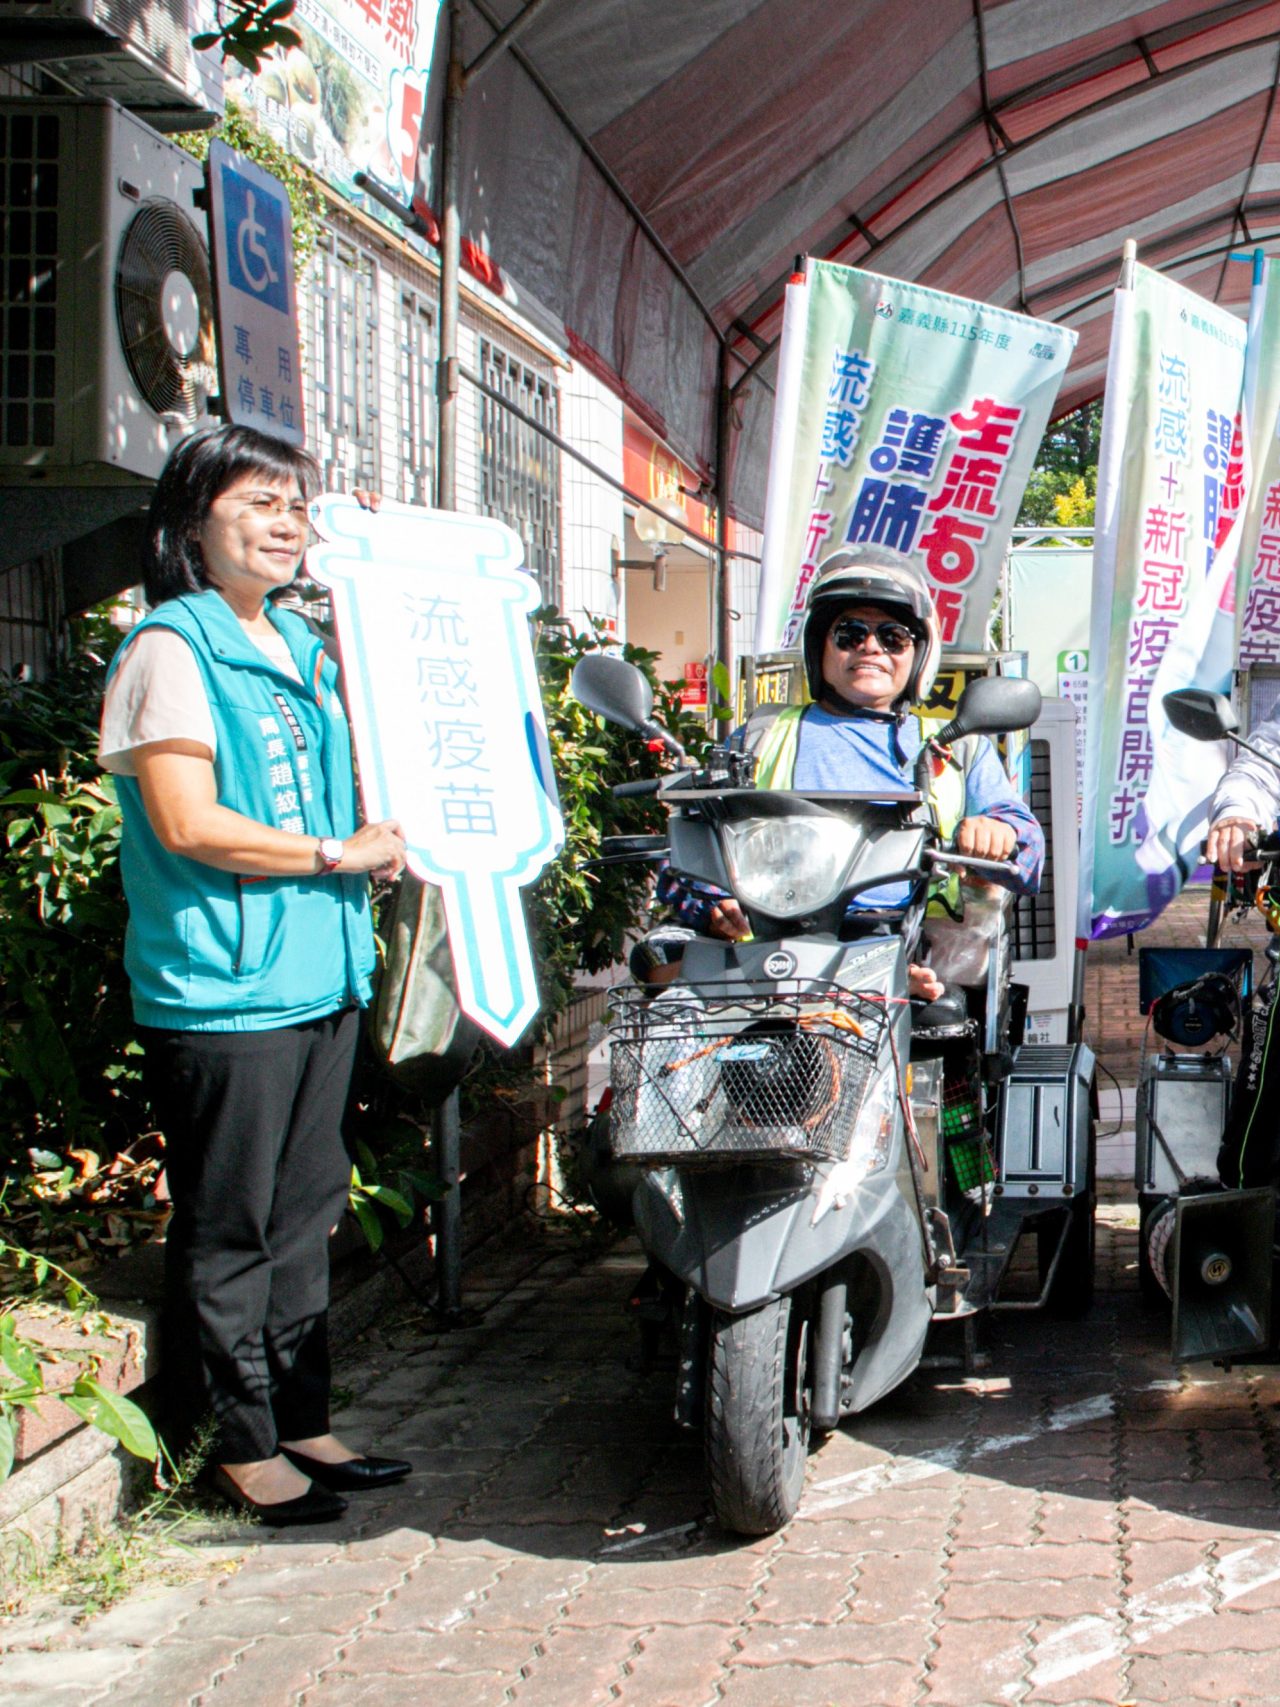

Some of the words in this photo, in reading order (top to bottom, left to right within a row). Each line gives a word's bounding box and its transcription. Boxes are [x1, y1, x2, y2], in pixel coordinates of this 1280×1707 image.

[234, 324, 293, 384] 專用
[898, 307, 1013, 351] 嘉義縣115年度
[238, 375, 296, 430] 停車位
[1069, 654, 1079, 670] 1
[403, 591, 497, 836] 流感疫苗
